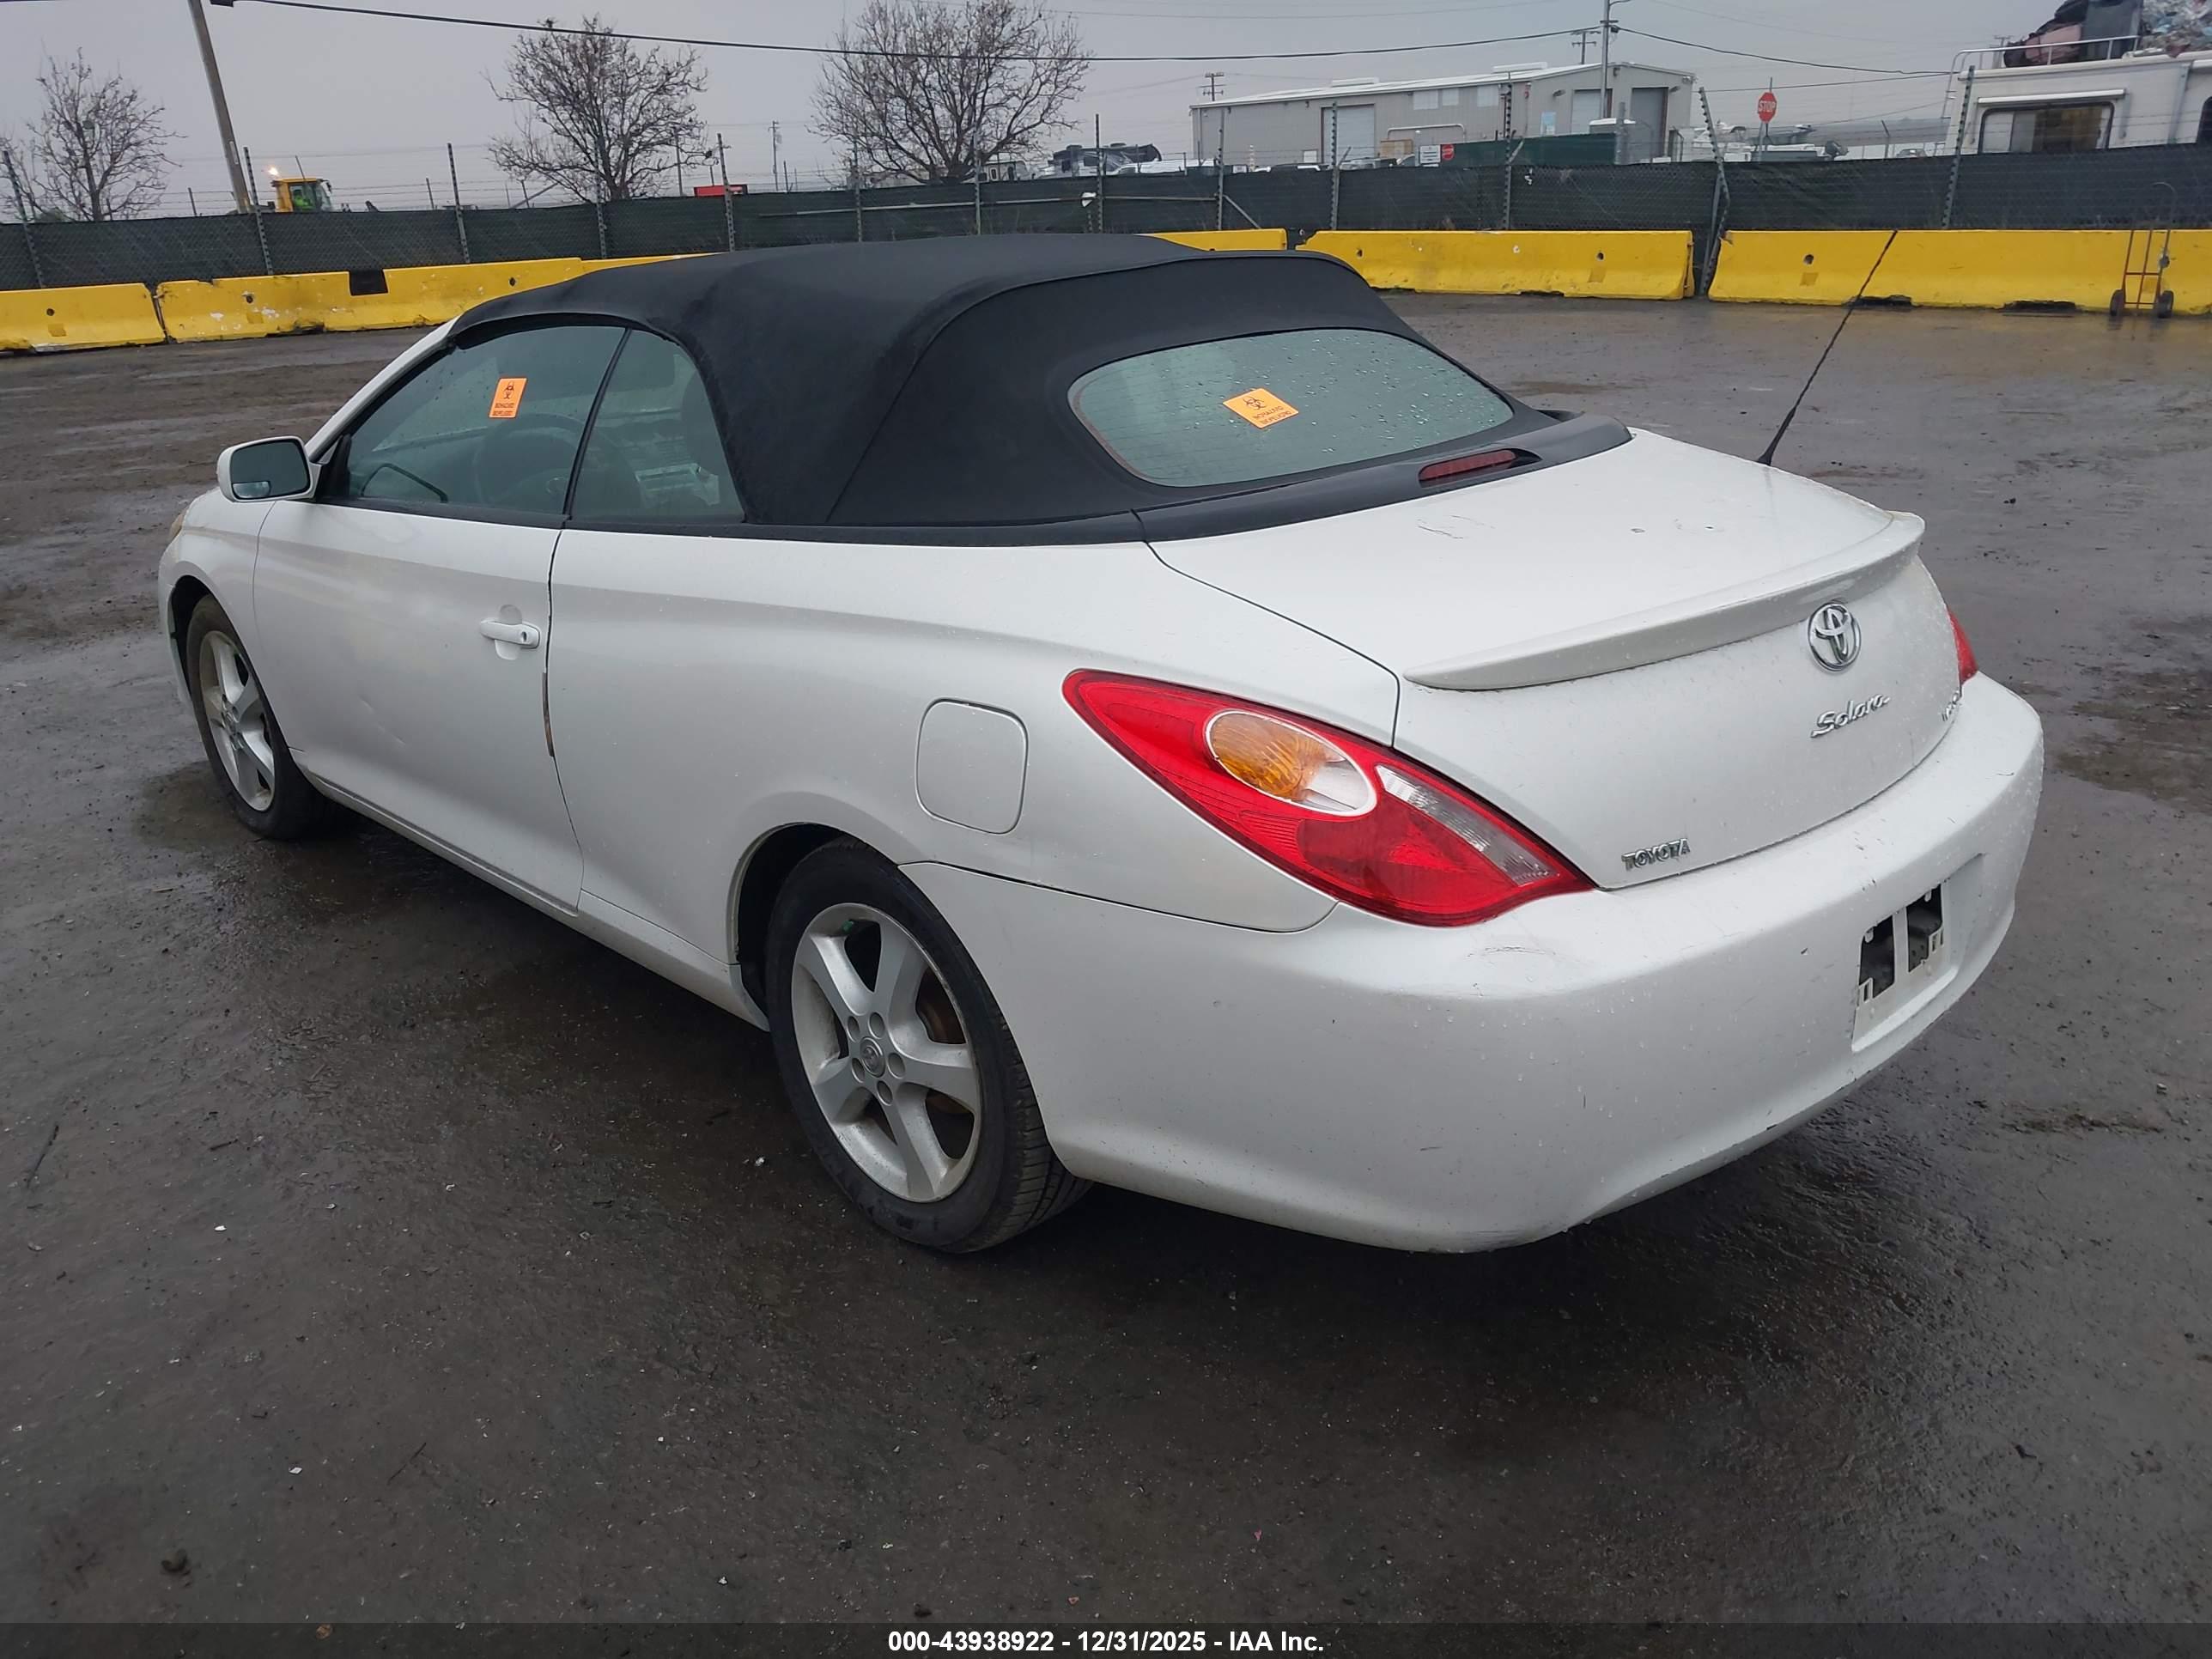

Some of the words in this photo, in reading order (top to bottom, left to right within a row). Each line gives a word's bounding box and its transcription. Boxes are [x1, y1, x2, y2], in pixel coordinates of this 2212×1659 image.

[1758, 100, 1777, 112] STOP
[1809, 694, 1891, 738] Solara
[1621, 838, 1691, 871] TOYOTA
